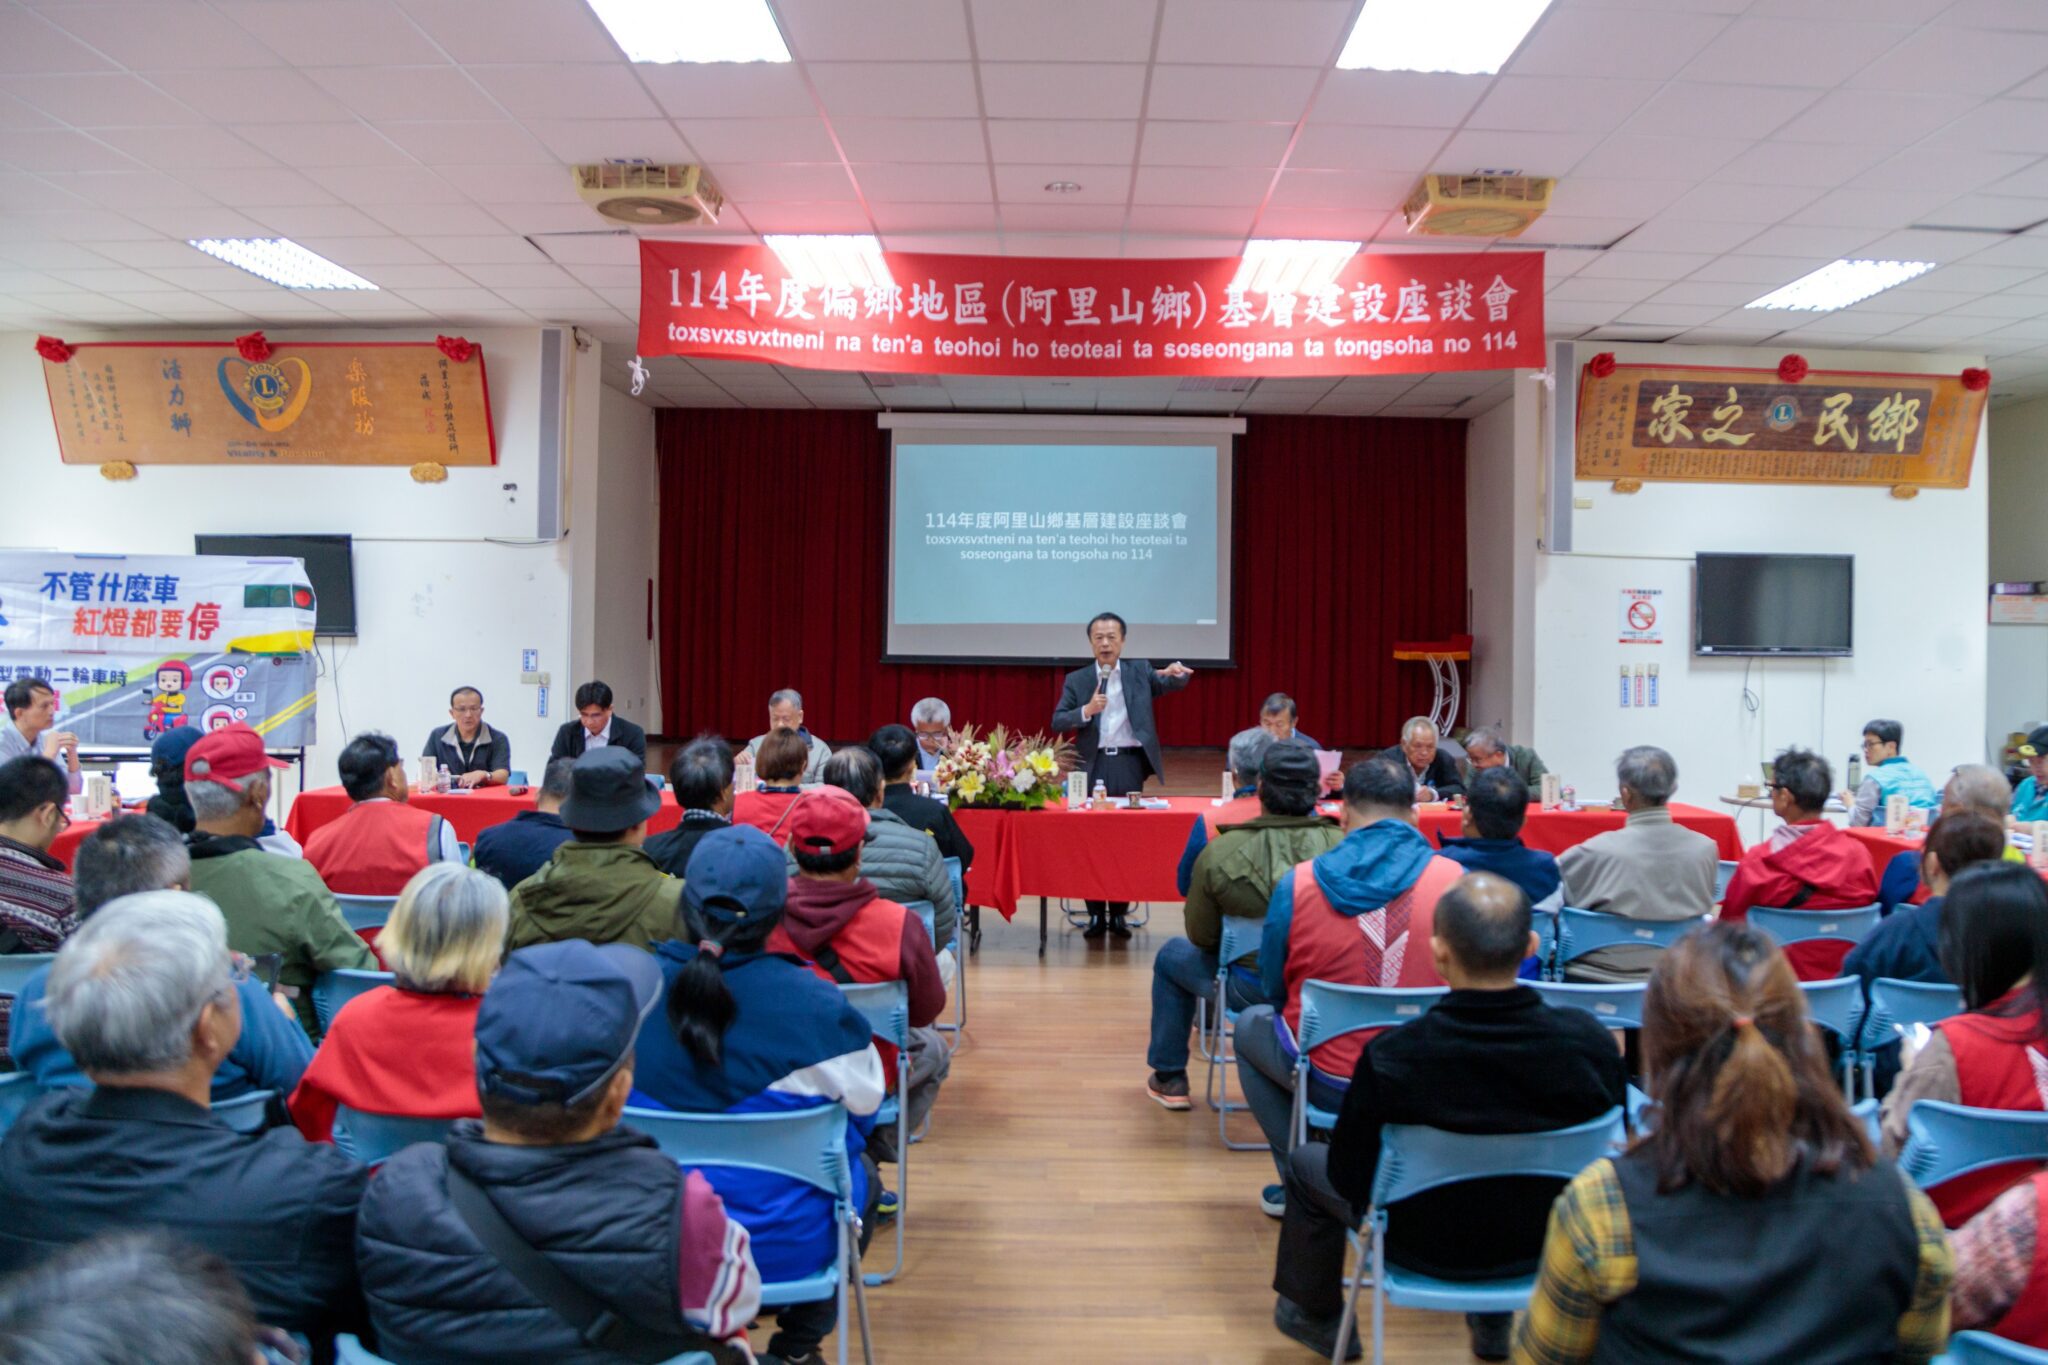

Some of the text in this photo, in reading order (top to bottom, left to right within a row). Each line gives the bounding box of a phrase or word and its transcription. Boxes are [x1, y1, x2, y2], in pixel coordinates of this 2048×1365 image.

[668, 322, 1518, 363] toxsvxsvxtneni na ten'a teohoi ho teoteai ta soseongana ta tongsoha no 114
[260, 377, 274, 396] L
[925, 511, 1188, 530] 114年度阿里山鄉基層建設座談會
[925, 533, 1188, 545] toxsvxsvxtneni na ten'a teohoi ho teoteai ta
[960, 548, 1153, 563] soseongana ta tongsoha no 114
[39, 571, 180, 605] 不管什麼車
[73, 601, 222, 641] 紅燈都要停
